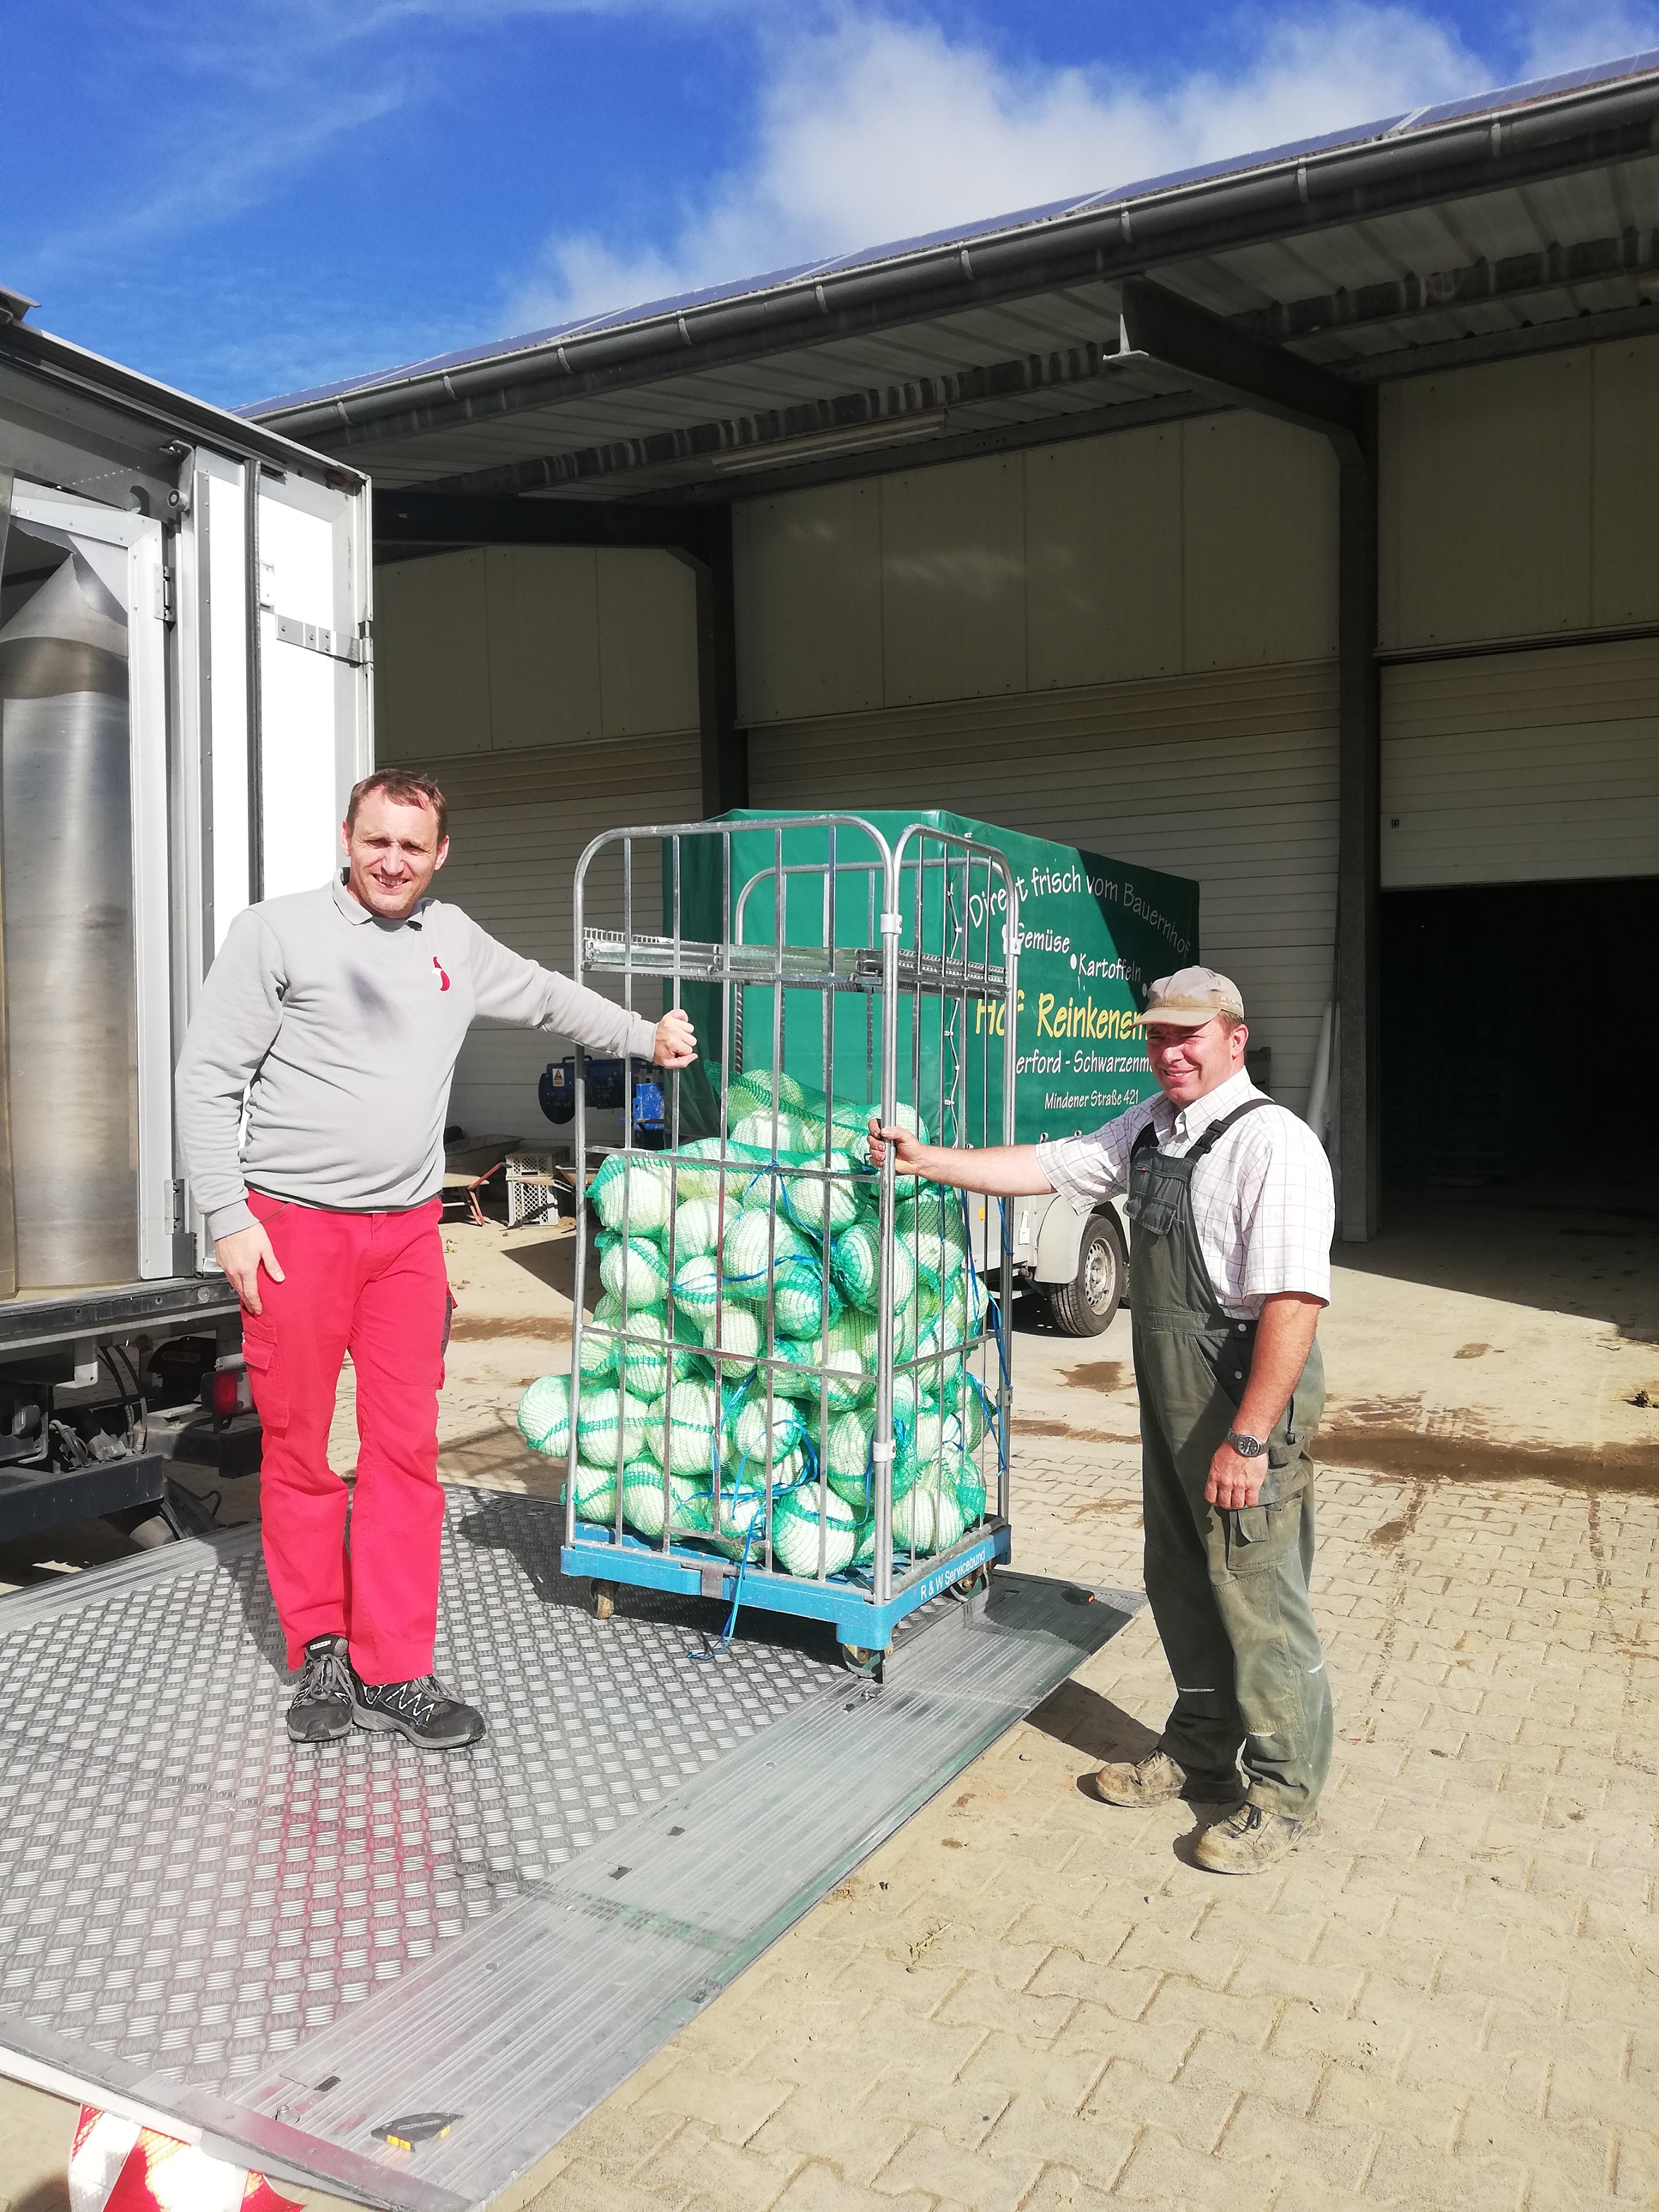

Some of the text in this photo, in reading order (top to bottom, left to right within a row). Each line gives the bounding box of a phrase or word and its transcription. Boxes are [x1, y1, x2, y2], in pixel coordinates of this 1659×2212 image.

[968, 864, 1191, 958] Diret frisch vom Bauernhof
[1078, 952, 1141, 982] Kartoffeln
[1036, 992, 1148, 1041] Reinkensm
[1016, 1048, 1062, 1074] erford
[1073, 1049, 1153, 1073] Schwarzenm
[1044, 1089, 1139, 1110] Mindener Straße 421
[920, 1546, 986, 1601] R & W Servicebund
